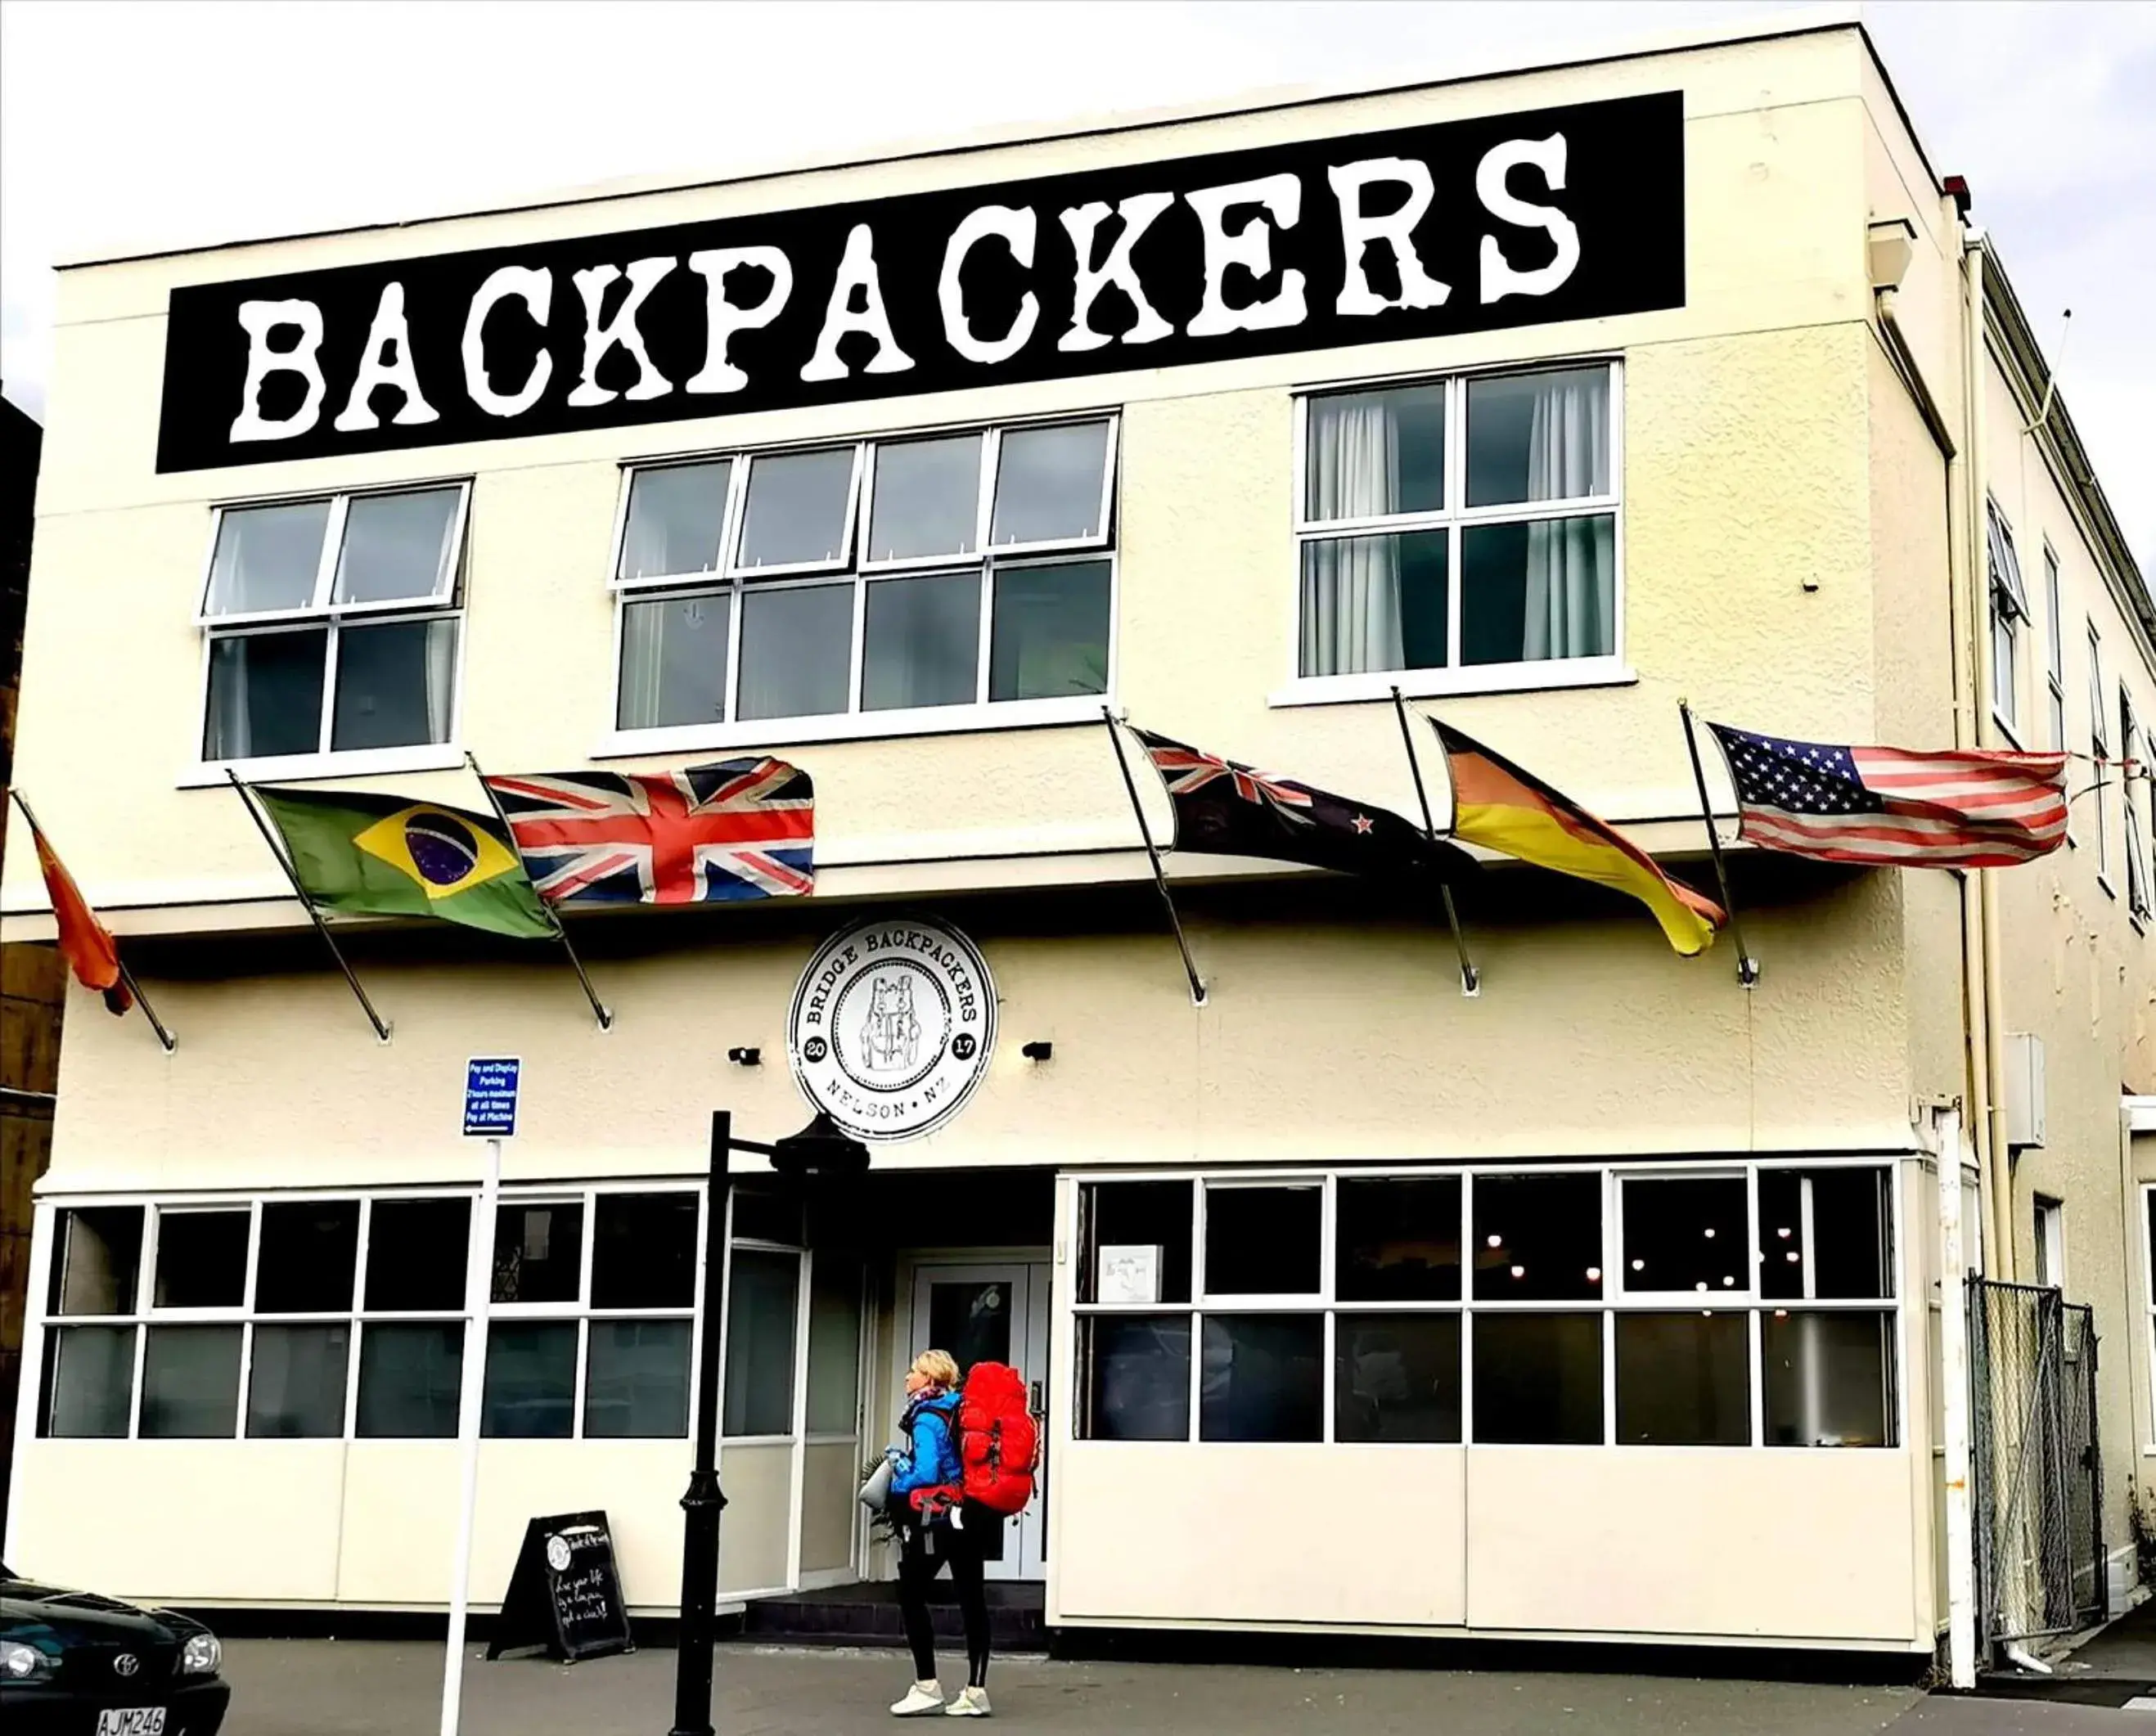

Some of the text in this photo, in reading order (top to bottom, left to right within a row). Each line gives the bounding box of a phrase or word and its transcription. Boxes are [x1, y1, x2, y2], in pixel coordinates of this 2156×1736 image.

[230, 133, 1580, 443] BACKPACKERS
[807, 929, 977, 1025] BRIDGE BACKPACKERS
[807, 1041, 825, 1058] 20
[955, 1038, 974, 1056] 17
[479, 1076, 506, 1086] Parking
[826, 1077, 951, 1119] NELSON NZ
[466, 1113, 478, 1123] Pay
[487, 1112, 512, 1122] Machine
[98, 1709, 163, 1736] AJM246
